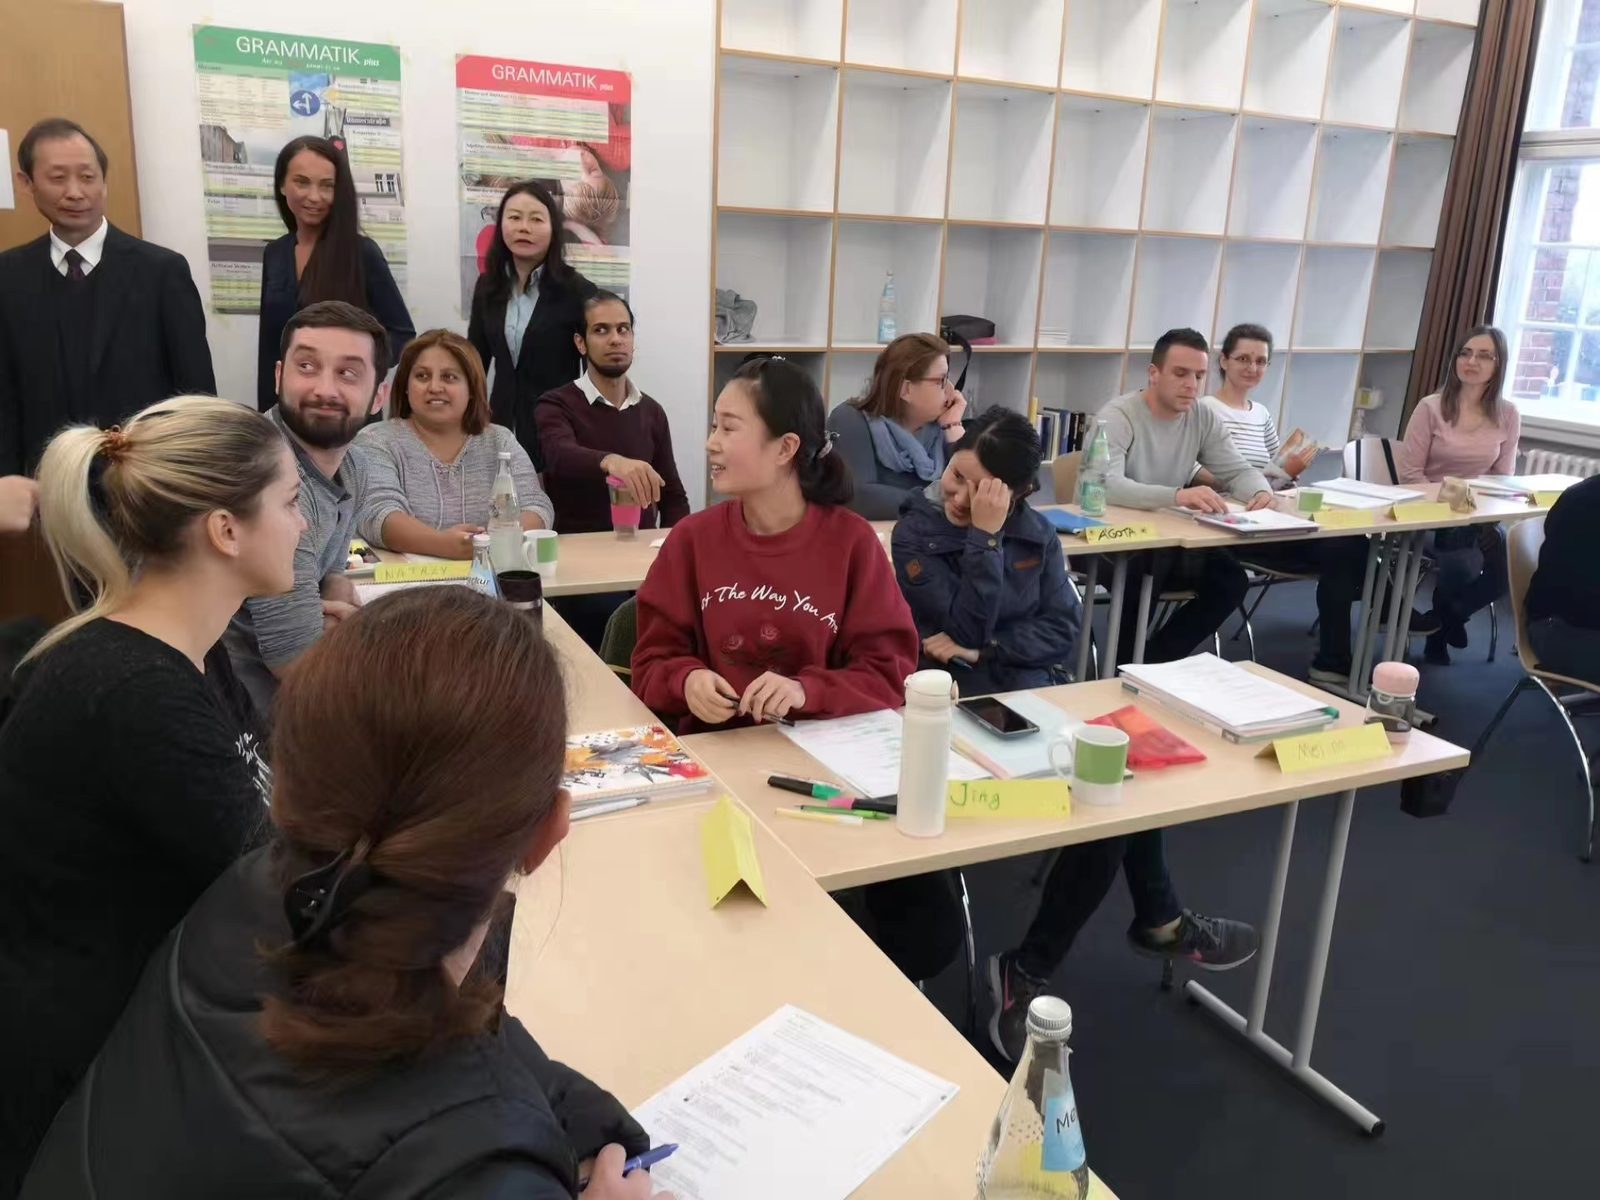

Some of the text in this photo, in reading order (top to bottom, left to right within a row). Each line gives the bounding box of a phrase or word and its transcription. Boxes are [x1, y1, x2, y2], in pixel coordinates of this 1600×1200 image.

[235, 36, 361, 65] GRAMMATIK
[363, 57, 380, 67] plus
[491, 64, 598, 90] GRAMMATIK
[714, 583, 747, 603] The
[751, 584, 787, 611] Way
[793, 590, 819, 617] You
[950, 783, 1000, 810] Jing
